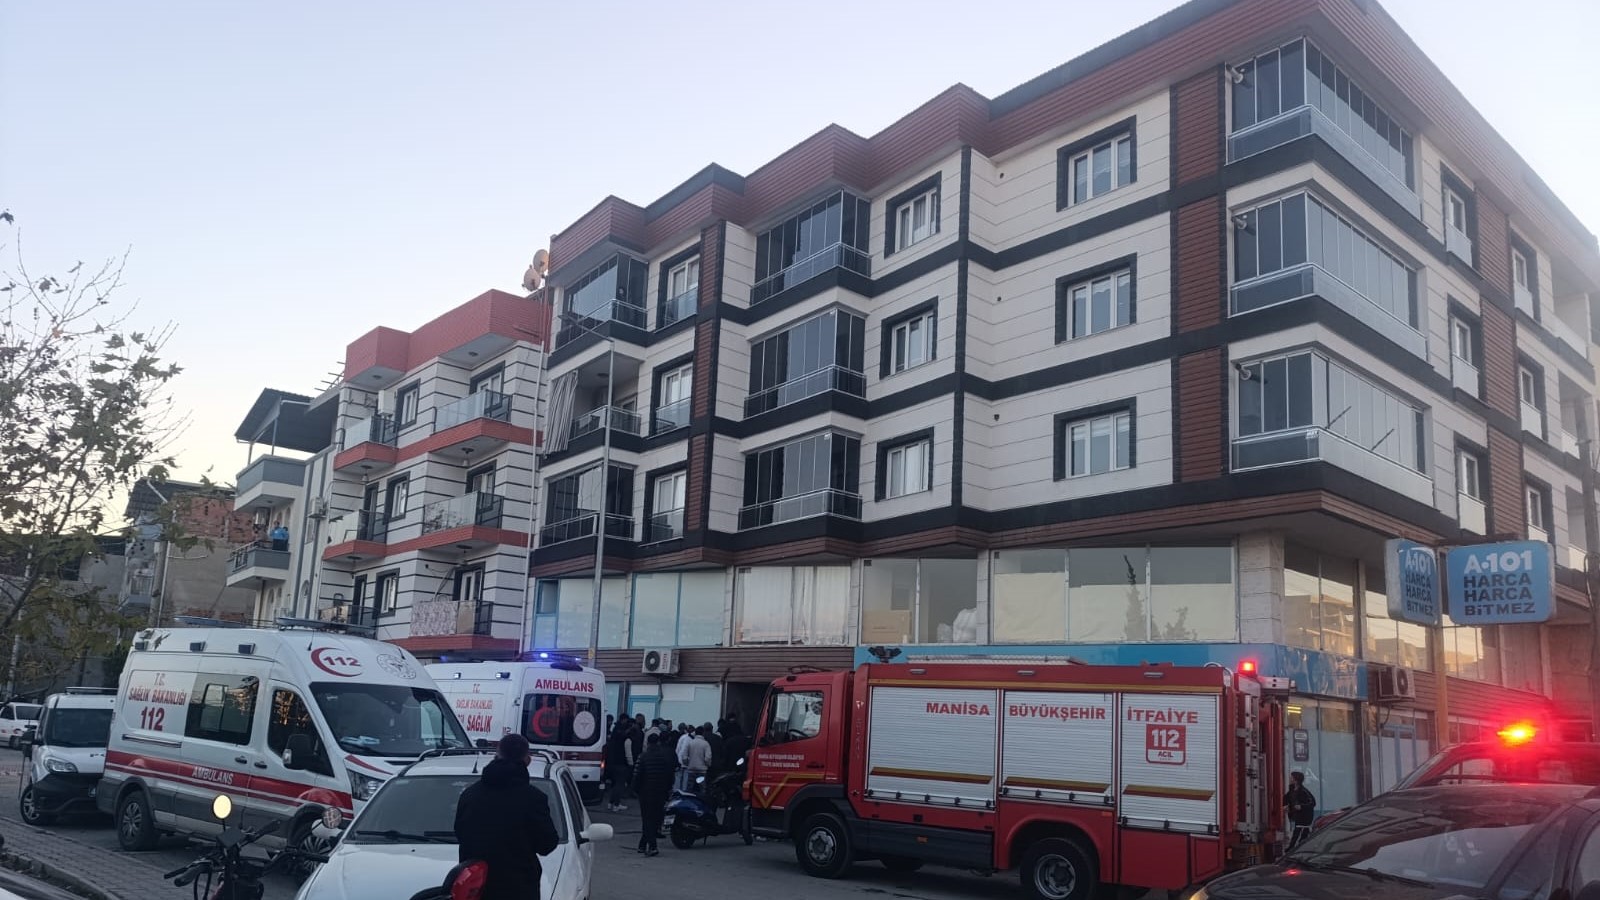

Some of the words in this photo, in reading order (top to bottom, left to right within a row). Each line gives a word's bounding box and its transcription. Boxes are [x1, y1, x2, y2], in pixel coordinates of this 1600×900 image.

[1405, 571, 1431, 589] HARCA
[1463, 572, 1532, 588] HARCA
[1406, 585, 1432, 604] HARCA
[1464, 587, 1532, 602] HARCA
[323, 656, 362, 667] 112
[535, 678, 594, 693] AMBULANS
[141, 706, 165, 731] 112
[466, 711, 492, 733] SAĞLIK
[926, 702, 990, 716] MANİSA
[1009, 703, 1106, 721] BÜYÜKŞEHİR
[1127, 706, 1199, 724] İTFAİYE
[1151, 729, 1180, 748] 112
[192, 765, 234, 785] AMBULANS
